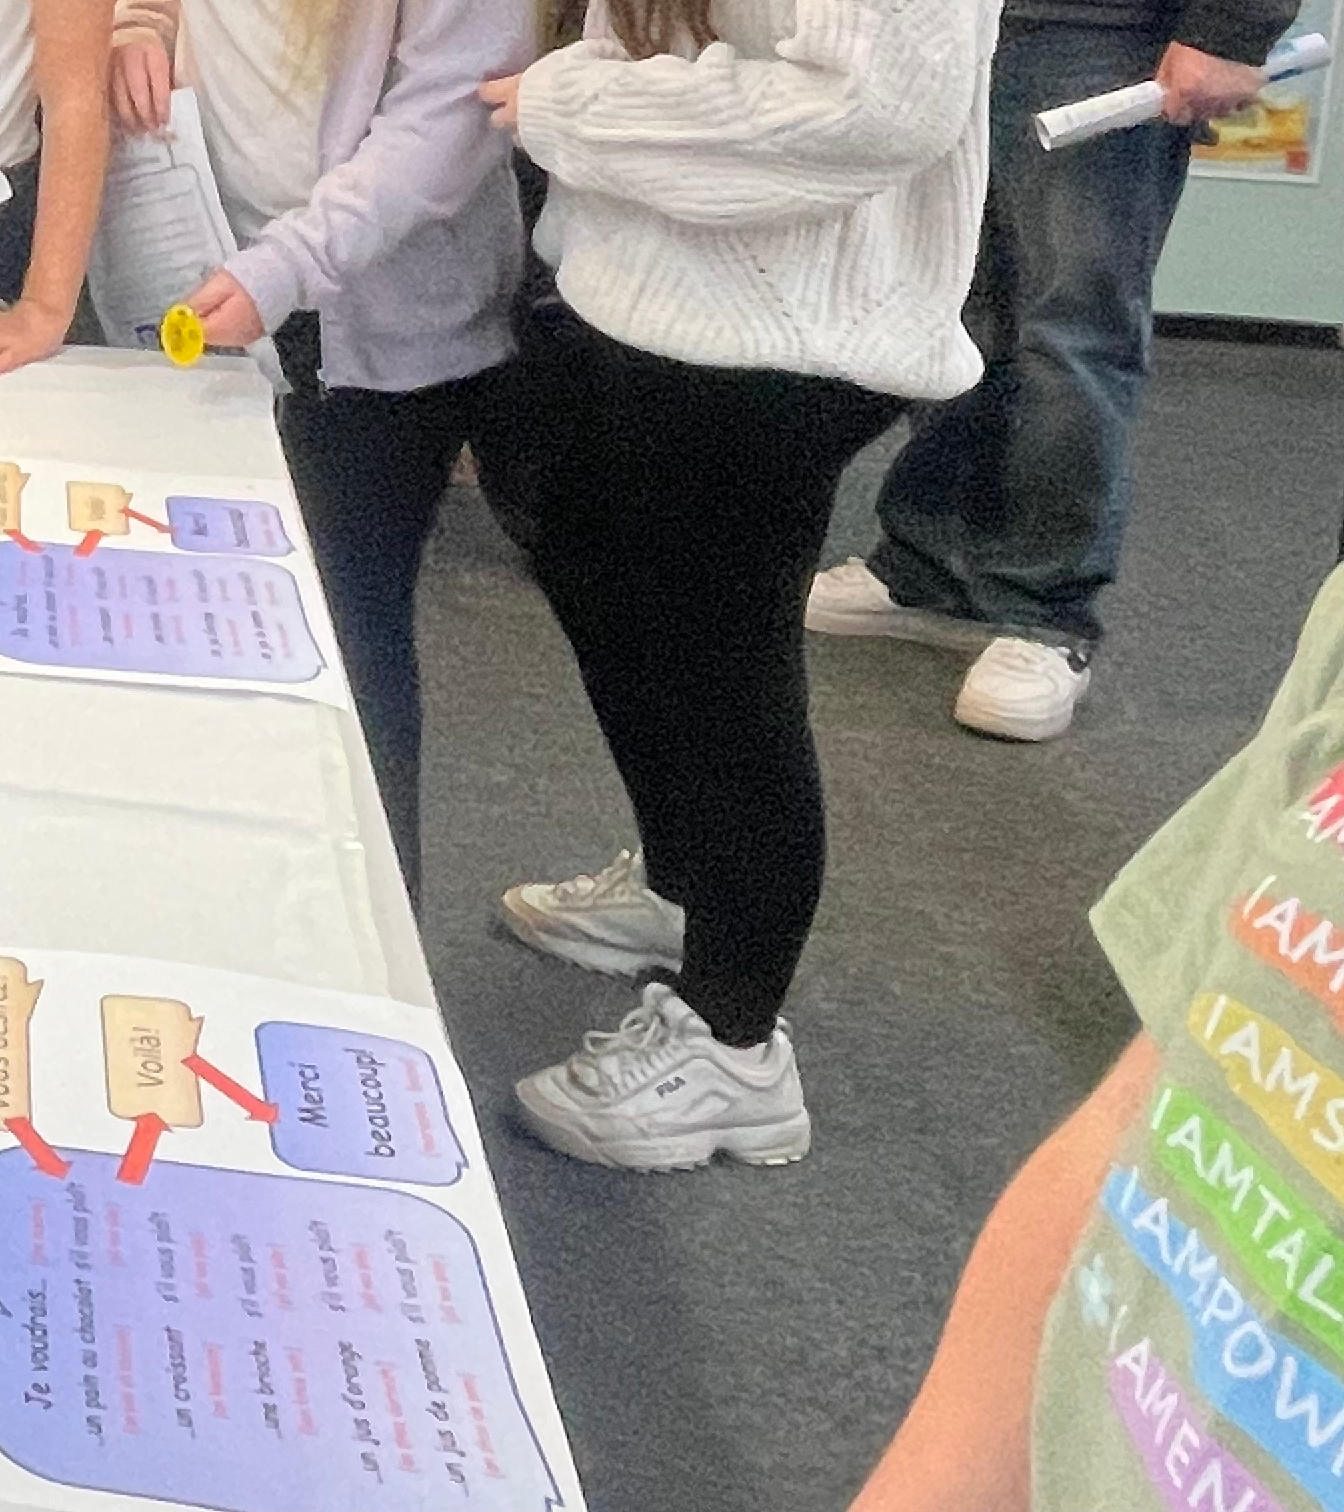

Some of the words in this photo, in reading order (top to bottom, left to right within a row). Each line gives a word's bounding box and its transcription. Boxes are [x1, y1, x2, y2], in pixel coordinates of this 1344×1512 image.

[130, 1025, 165, 1089] Voilà!
[287, 1059, 331, 1129] Merci
[341, 1046, 397, 1159] beaucoup!
[71, 1277, 97, 1345] chocolat
[81, 1348, 99, 1370] au
[164, 1324, 193, 1403] croissant
[247, 1339, 276, 1397] brioche
[414, 1337, 450, 1395] pomme
[23, 1381, 54, 1411] Je
[79, 1373, 109, 1410] pain
[425, 1399, 451, 1423] de
[352, 1416, 382, 1447] jus
[436, 1428, 468, 1459] jus
